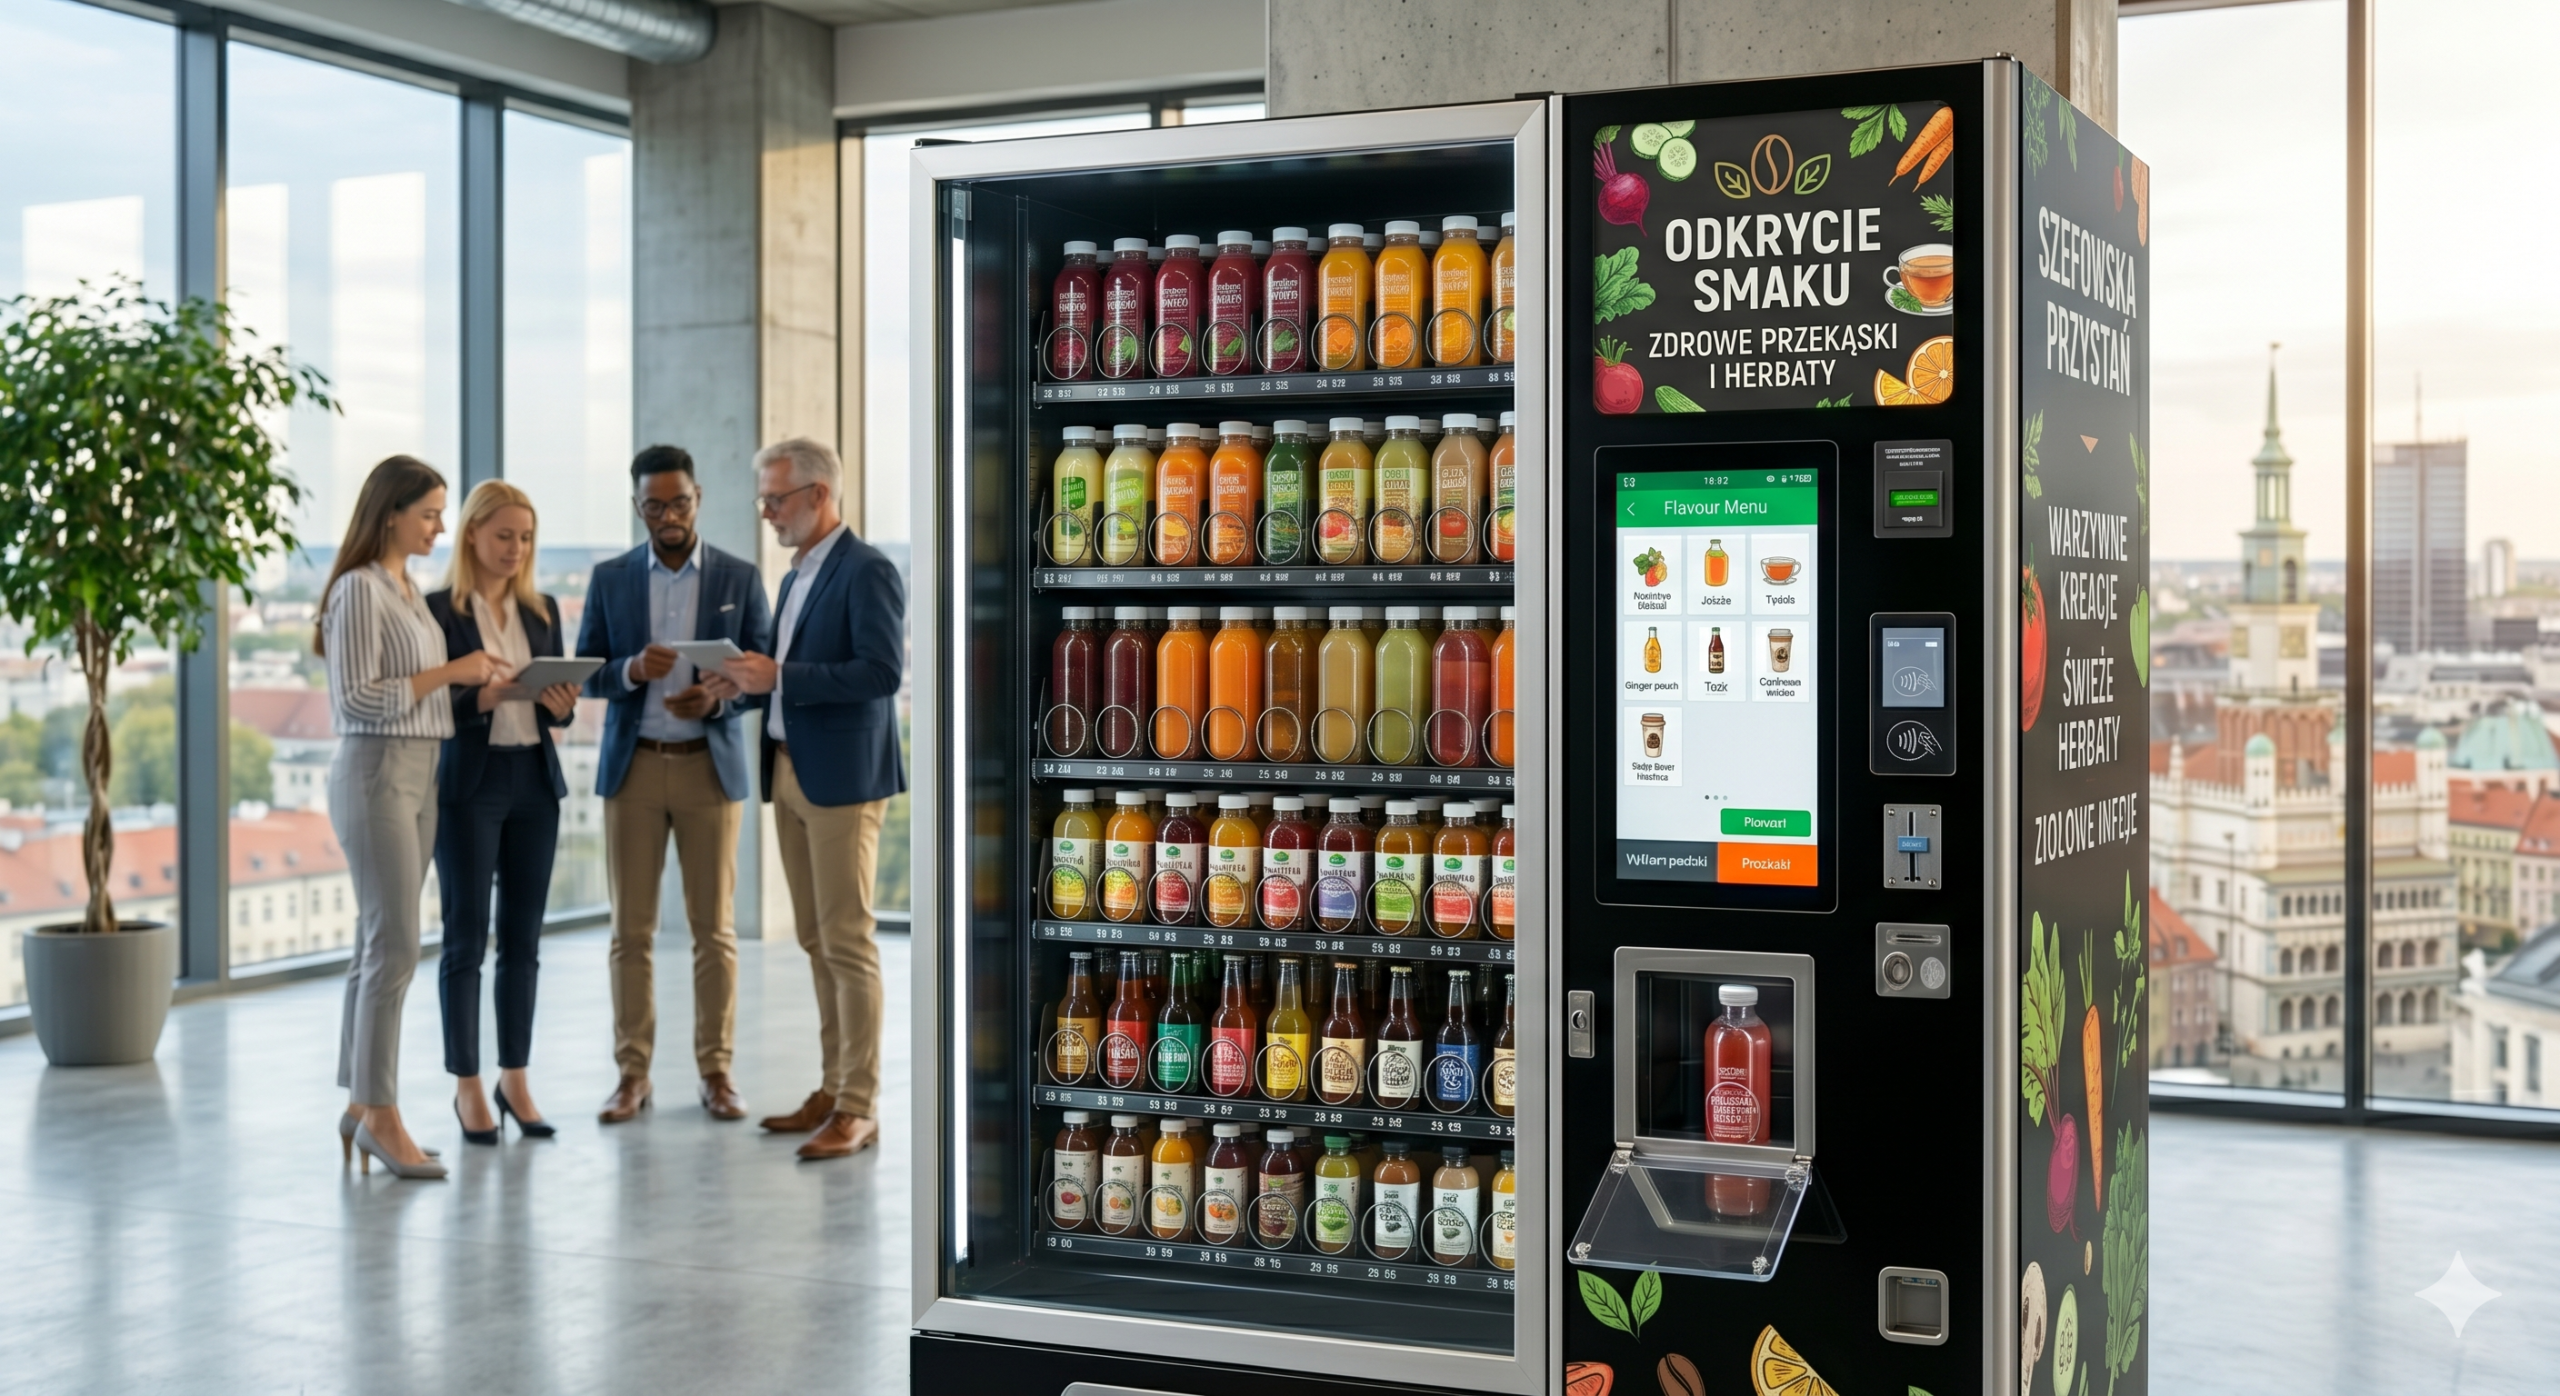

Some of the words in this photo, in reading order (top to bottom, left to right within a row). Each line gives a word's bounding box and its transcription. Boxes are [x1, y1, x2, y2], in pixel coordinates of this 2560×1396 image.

[1665, 207, 1882, 262] ODKRYCIE
[2038, 206, 2137, 318] SZEFOWSKA
[1694, 263, 1850, 312] SMAKU
[1649, 329, 1753, 358] ZDROWE
[1761, 323, 1898, 356] PRZEKĄSKI
[2047, 319, 2130, 396] PRZYSTAŃ
[1710, 363, 1715, 388] I
[1725, 360, 1837, 388] HERBATY
[1664, 500, 1720, 515] Flavour
[1725, 500, 1767, 514] Menu
[2048, 505, 2128, 562] WARZYWNE
[2060, 571, 2118, 629] KREACJE
[1625, 682, 1652, 691] Ginger
[2062, 646, 2114, 707] ŚWIEŻE
[2058, 716, 2121, 771] HERBATY
[2035, 803, 2095, 866] ZIOLOWE
